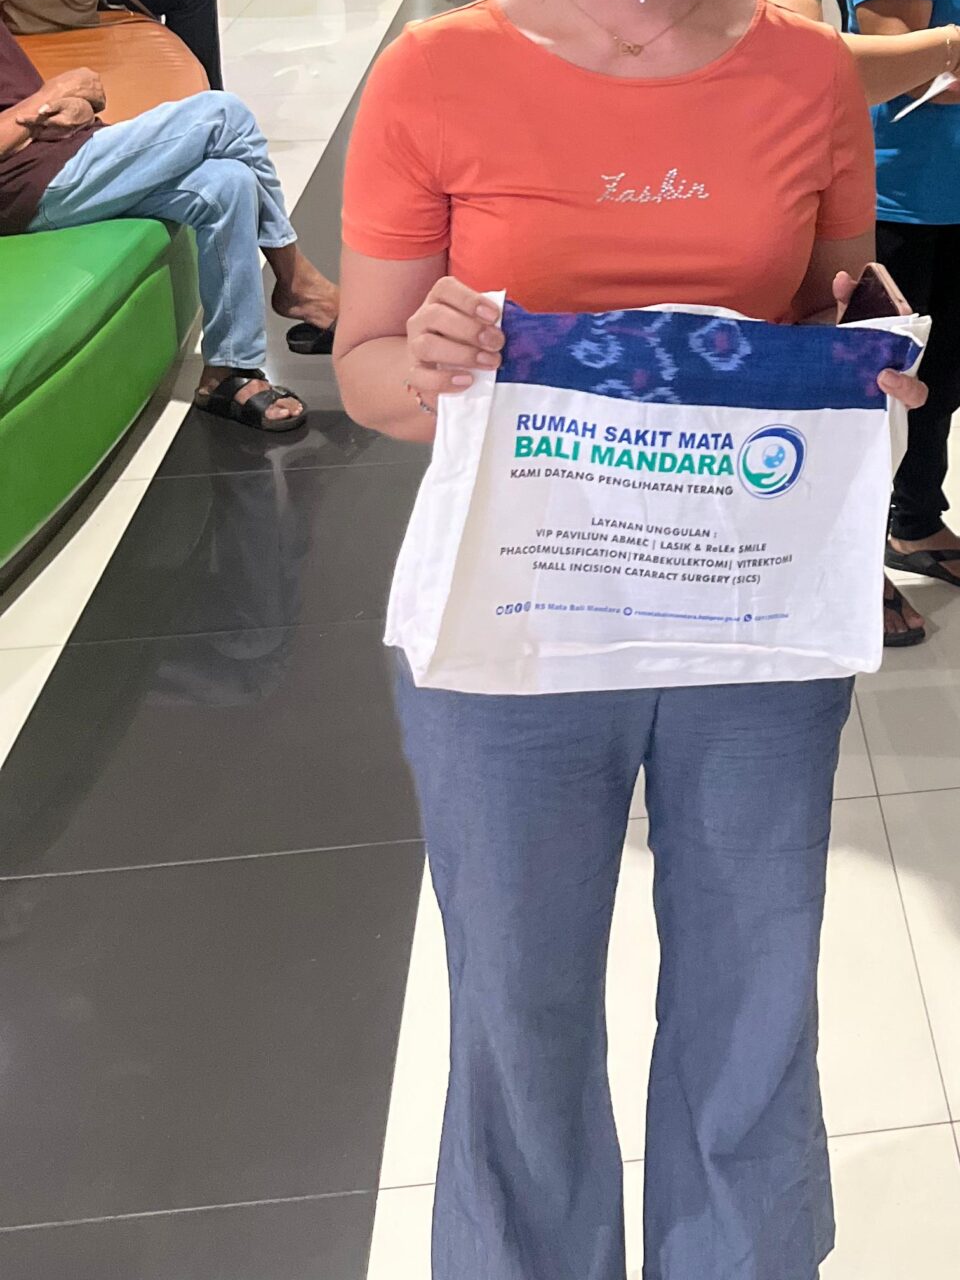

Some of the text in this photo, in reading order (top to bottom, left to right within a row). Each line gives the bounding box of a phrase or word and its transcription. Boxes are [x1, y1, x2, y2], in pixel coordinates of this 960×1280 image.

[516, 413, 734, 450] RUMAH SAKIT MATA
[514, 435, 734, 476] BALI MANDARA
[510, 468, 734, 496] KAMI DATANG PENGLIHATAN TERANG
[591, 517, 644, 532] LAYANAN
[645, 524, 711, 538] UNGGULAN
[536, 528, 553, 538] VIP
[555, 529, 609, 542] PAVILIUN
[611, 534, 649, 547] ABMEC
[660, 541, 691, 551] LASIK
[694, 544, 702, 552] &
[738, 543, 767, 554] SMILE
[532, 560, 761, 586] SMALL INCISION CATARACT SURGERY (SICS)
[737, 554, 793, 569] VITREKTOMI
